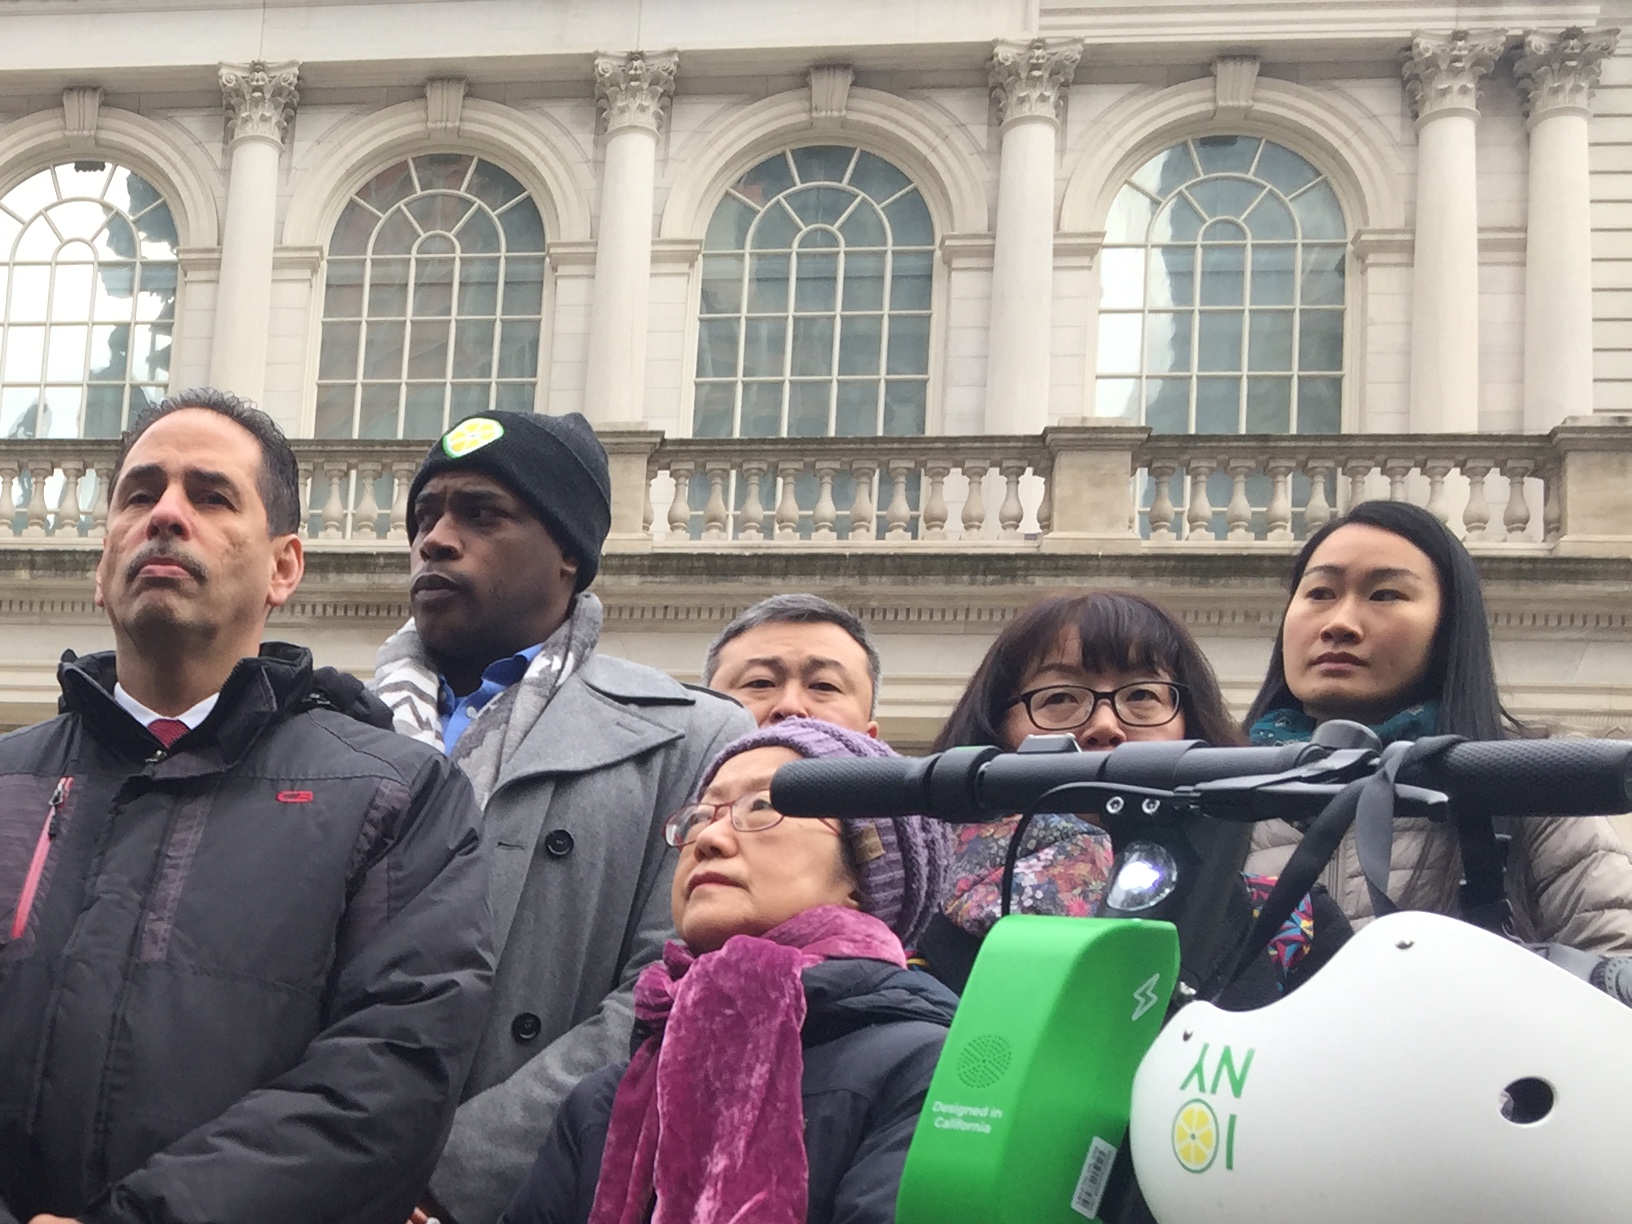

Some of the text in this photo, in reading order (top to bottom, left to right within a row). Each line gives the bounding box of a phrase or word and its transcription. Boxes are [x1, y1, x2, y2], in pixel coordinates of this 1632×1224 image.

[1179, 1042, 1257, 1099] NY
[932, 1101, 1003, 1119] Designed in
[934, 1116, 992, 1134] California
